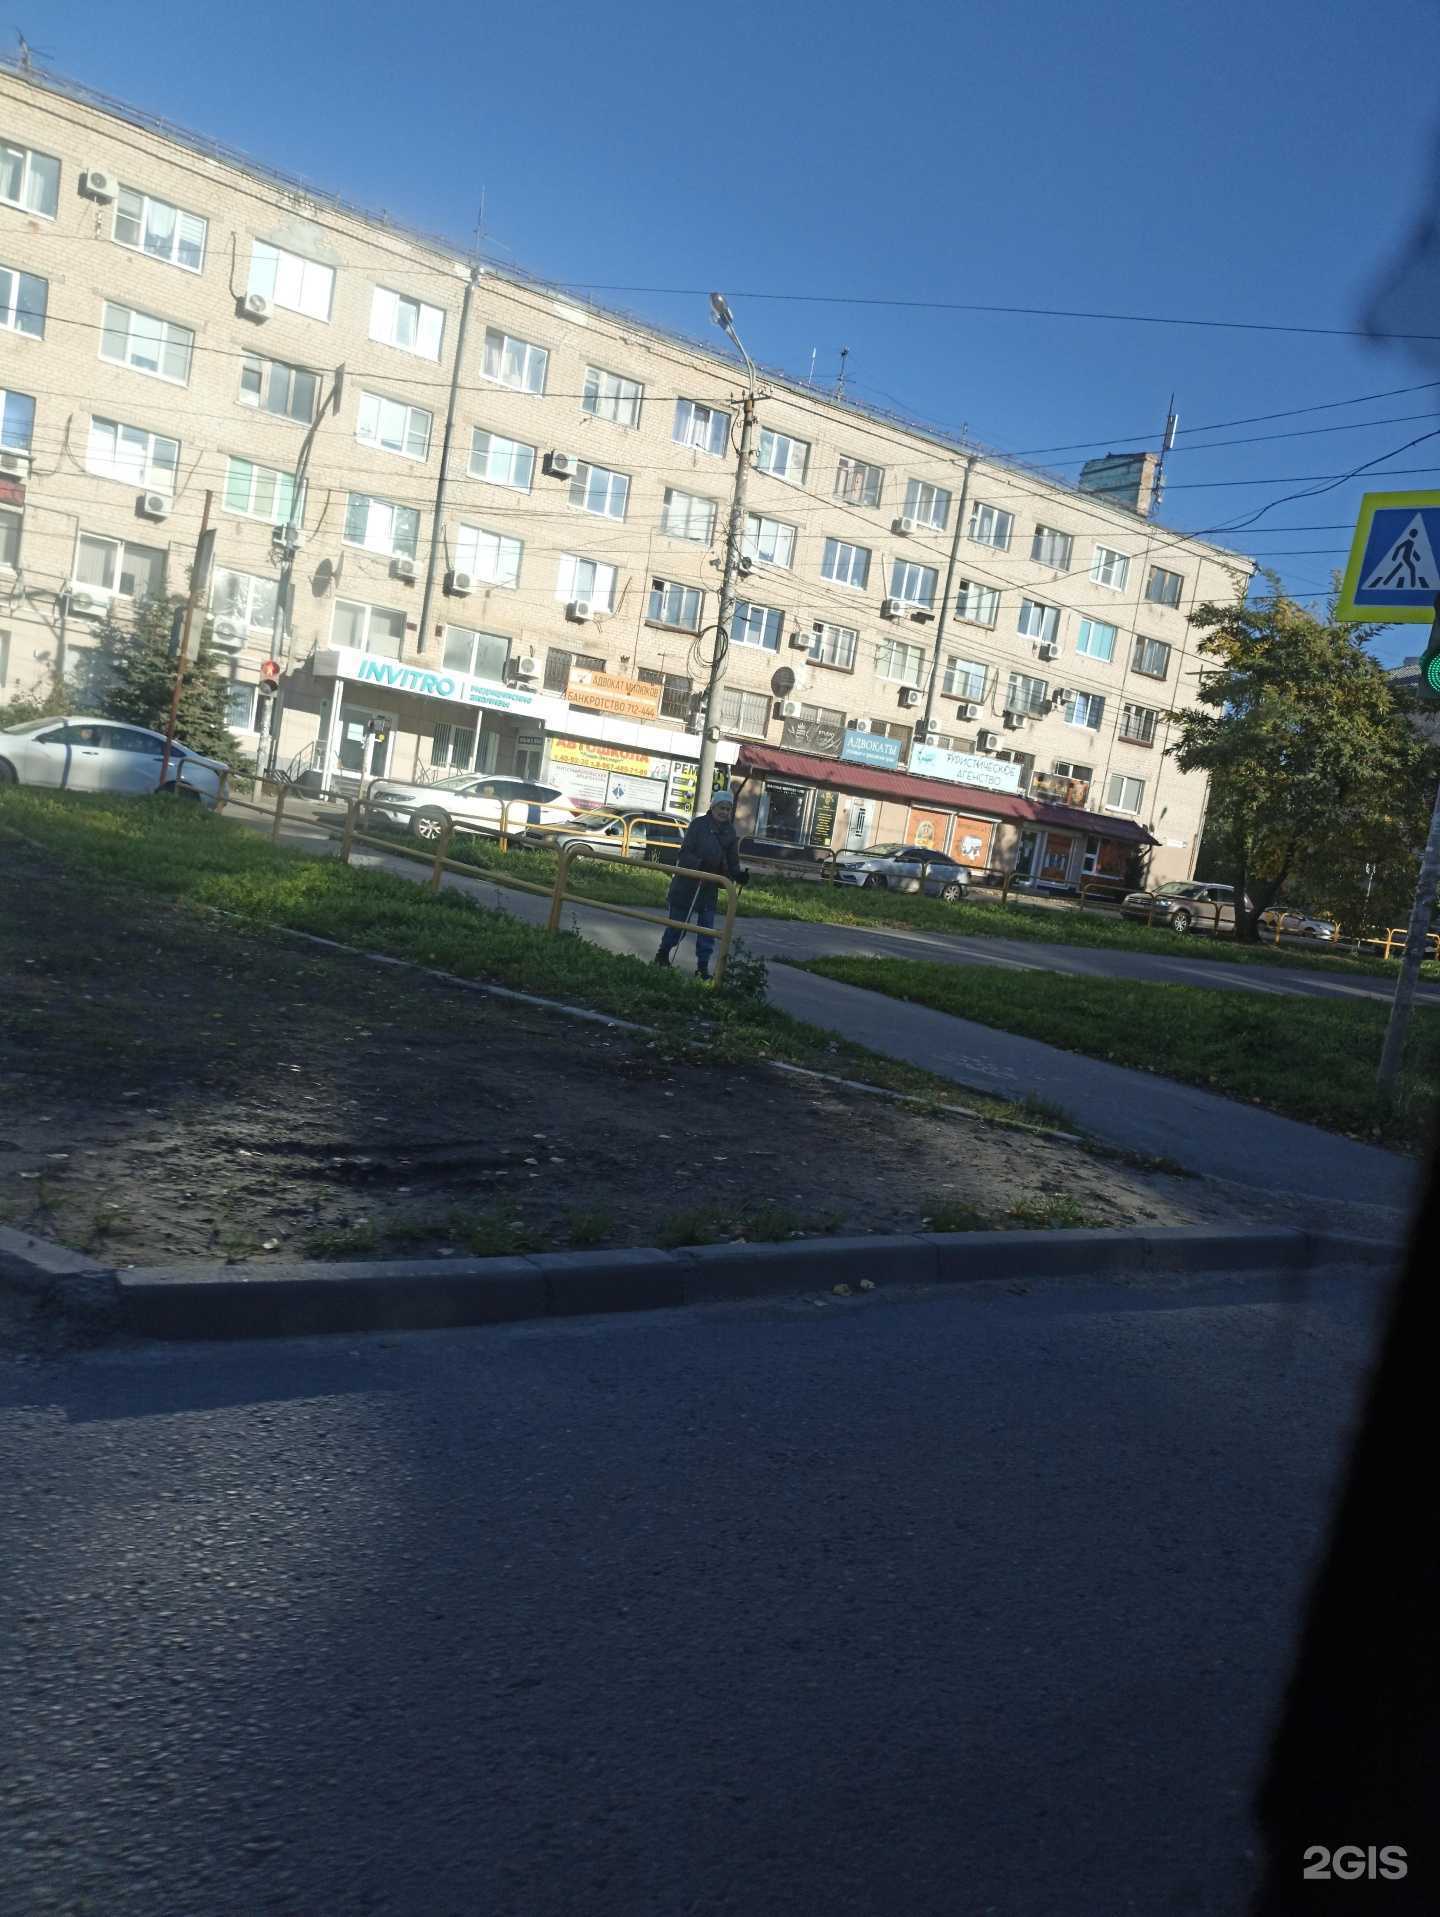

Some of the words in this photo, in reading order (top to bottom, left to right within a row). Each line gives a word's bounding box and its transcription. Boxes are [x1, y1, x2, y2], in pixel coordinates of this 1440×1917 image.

[358, 660, 455, 696] INVITRO
[592, 675, 624, 690] АДВОКАТ
[567, 691, 625, 713] БАНКРОТСТВО
[627, 703, 655, 718] 712-444
[847, 736, 897, 755] АДВОКАТЫ
[946, 753, 1016, 777] ТУРИСТИЧЕСКОЕ
